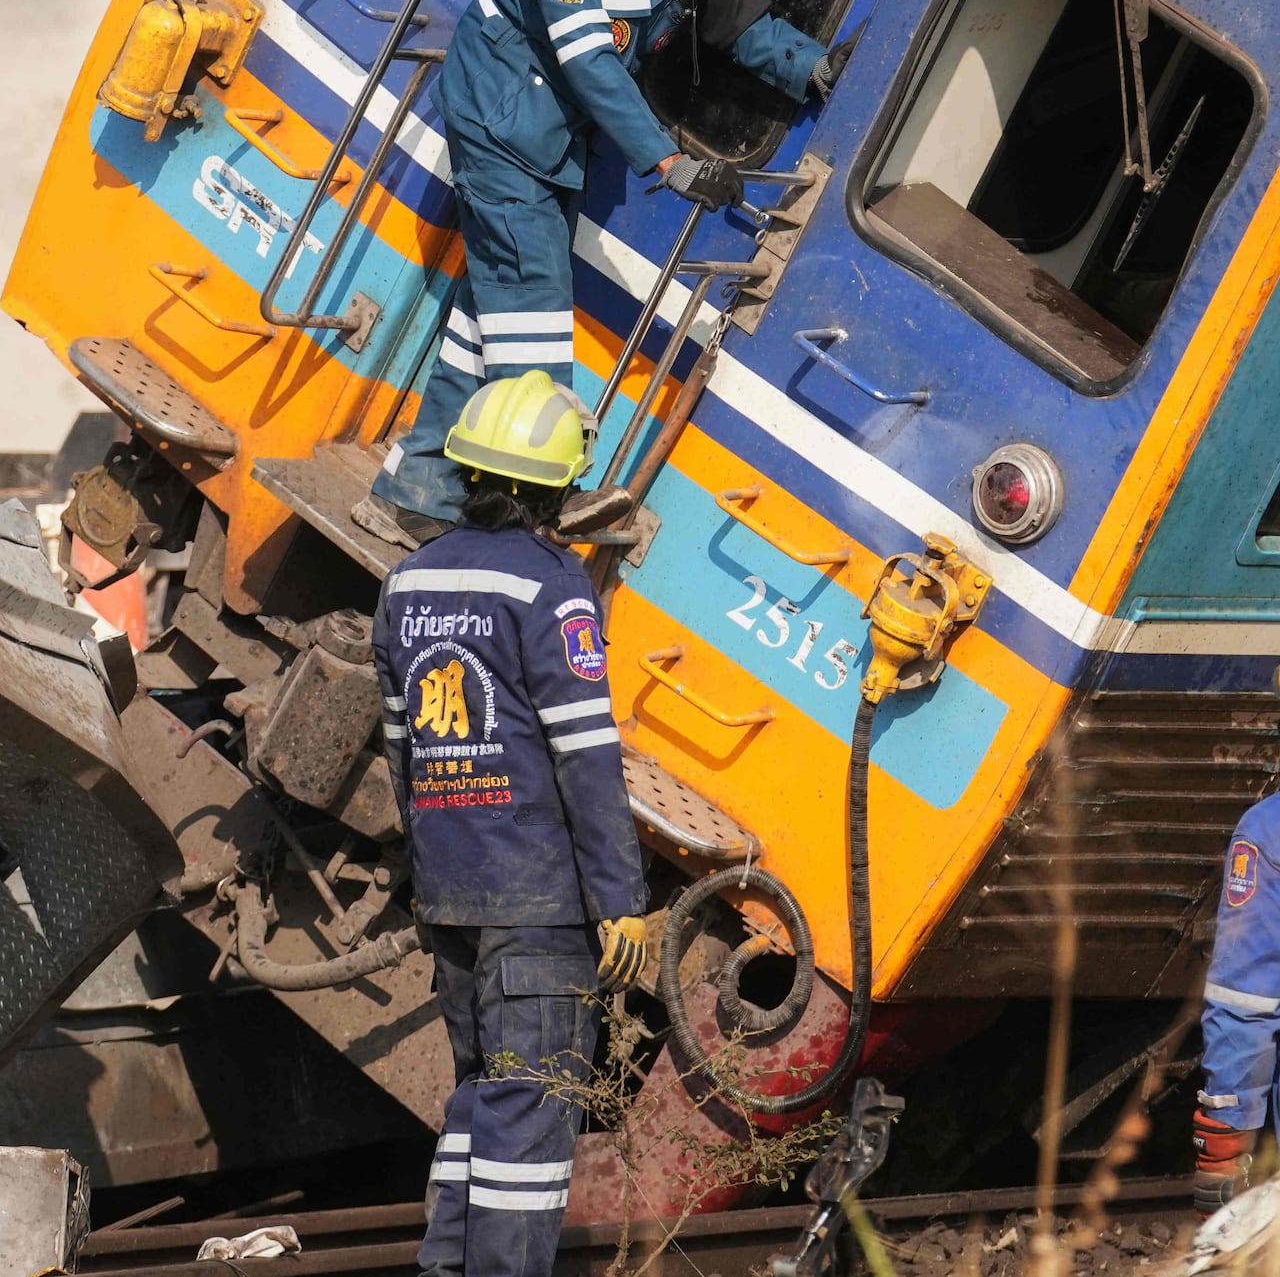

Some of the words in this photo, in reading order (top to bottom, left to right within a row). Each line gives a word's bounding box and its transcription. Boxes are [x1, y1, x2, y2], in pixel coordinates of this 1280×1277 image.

[192, 155, 326, 280] SRT
[400, 604, 493, 648] กู้ภัยสว่าง
[725, 576, 859, 690] 2515
